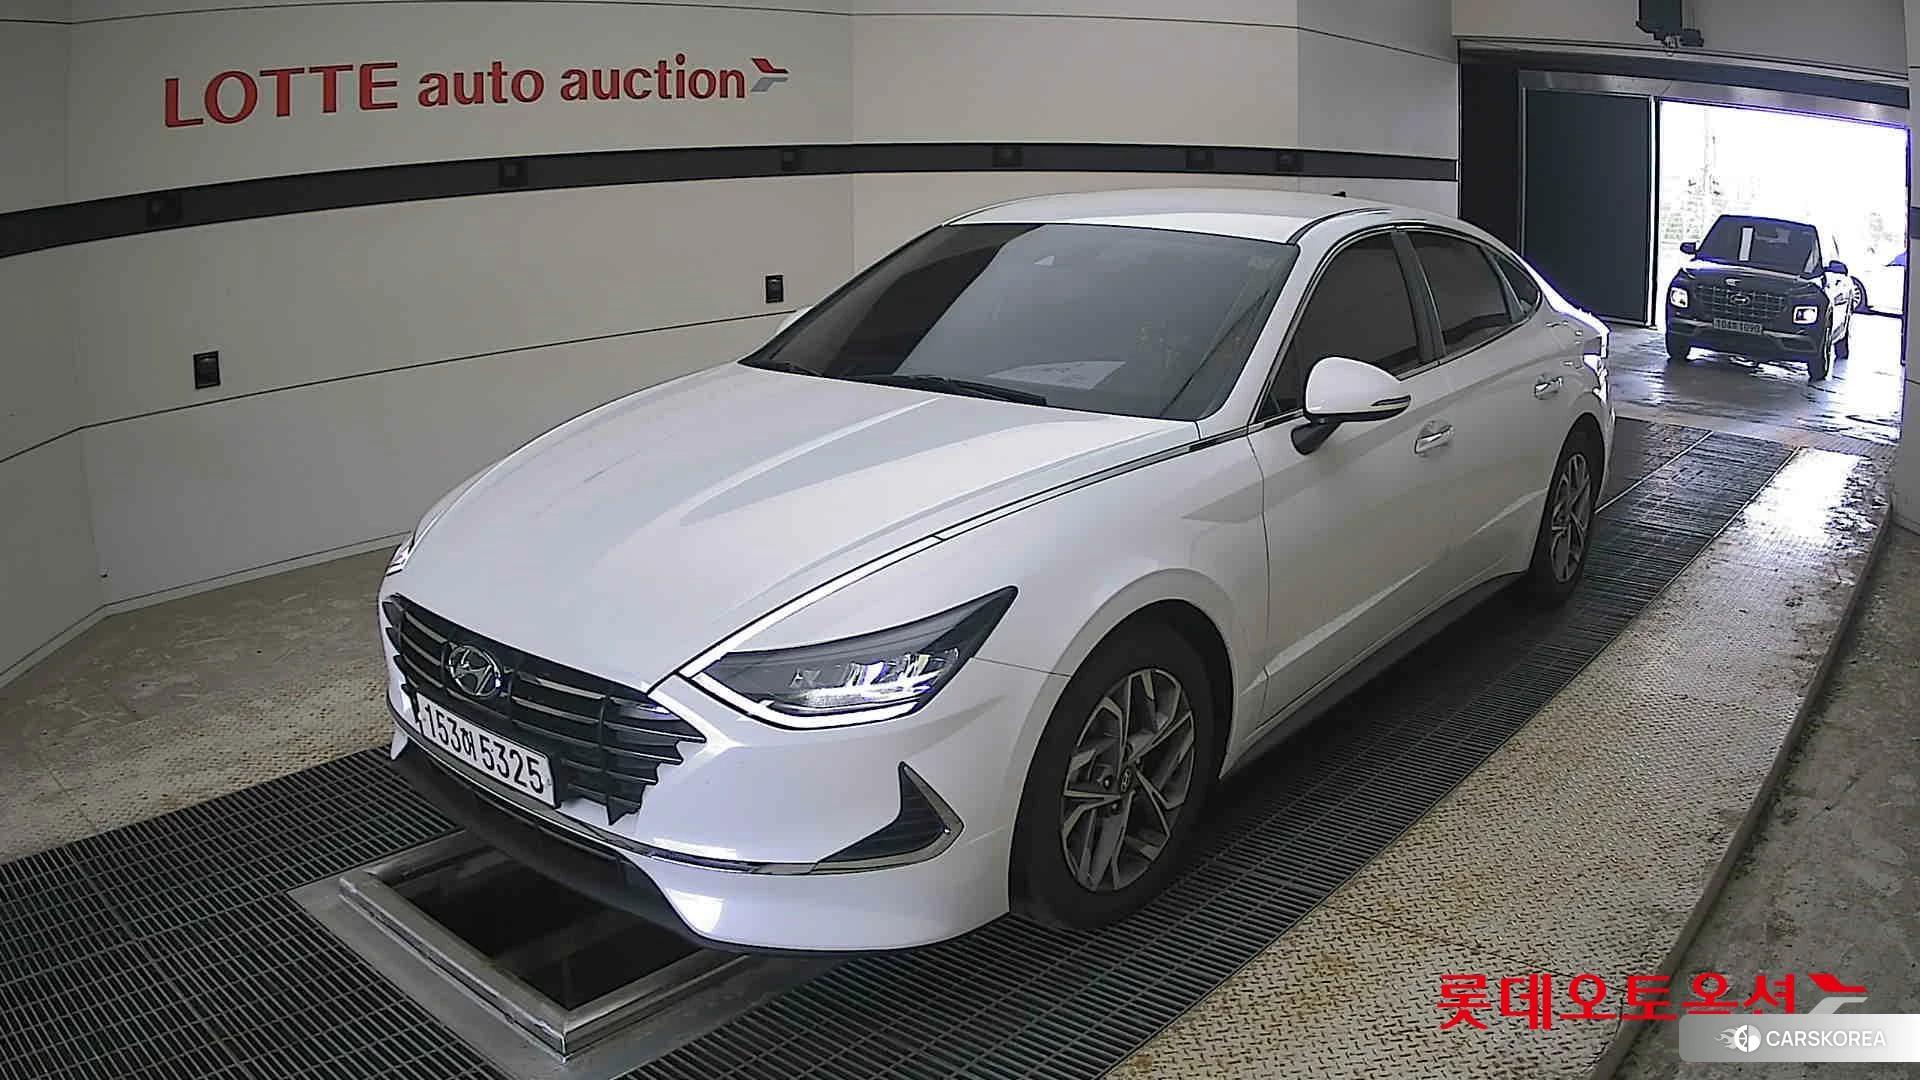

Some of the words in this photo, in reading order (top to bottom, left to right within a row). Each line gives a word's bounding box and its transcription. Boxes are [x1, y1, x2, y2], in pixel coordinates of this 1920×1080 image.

[163, 62, 399, 128] LOTTE
[417, 61, 544, 107] auto
[560, 53, 746, 101] auction
